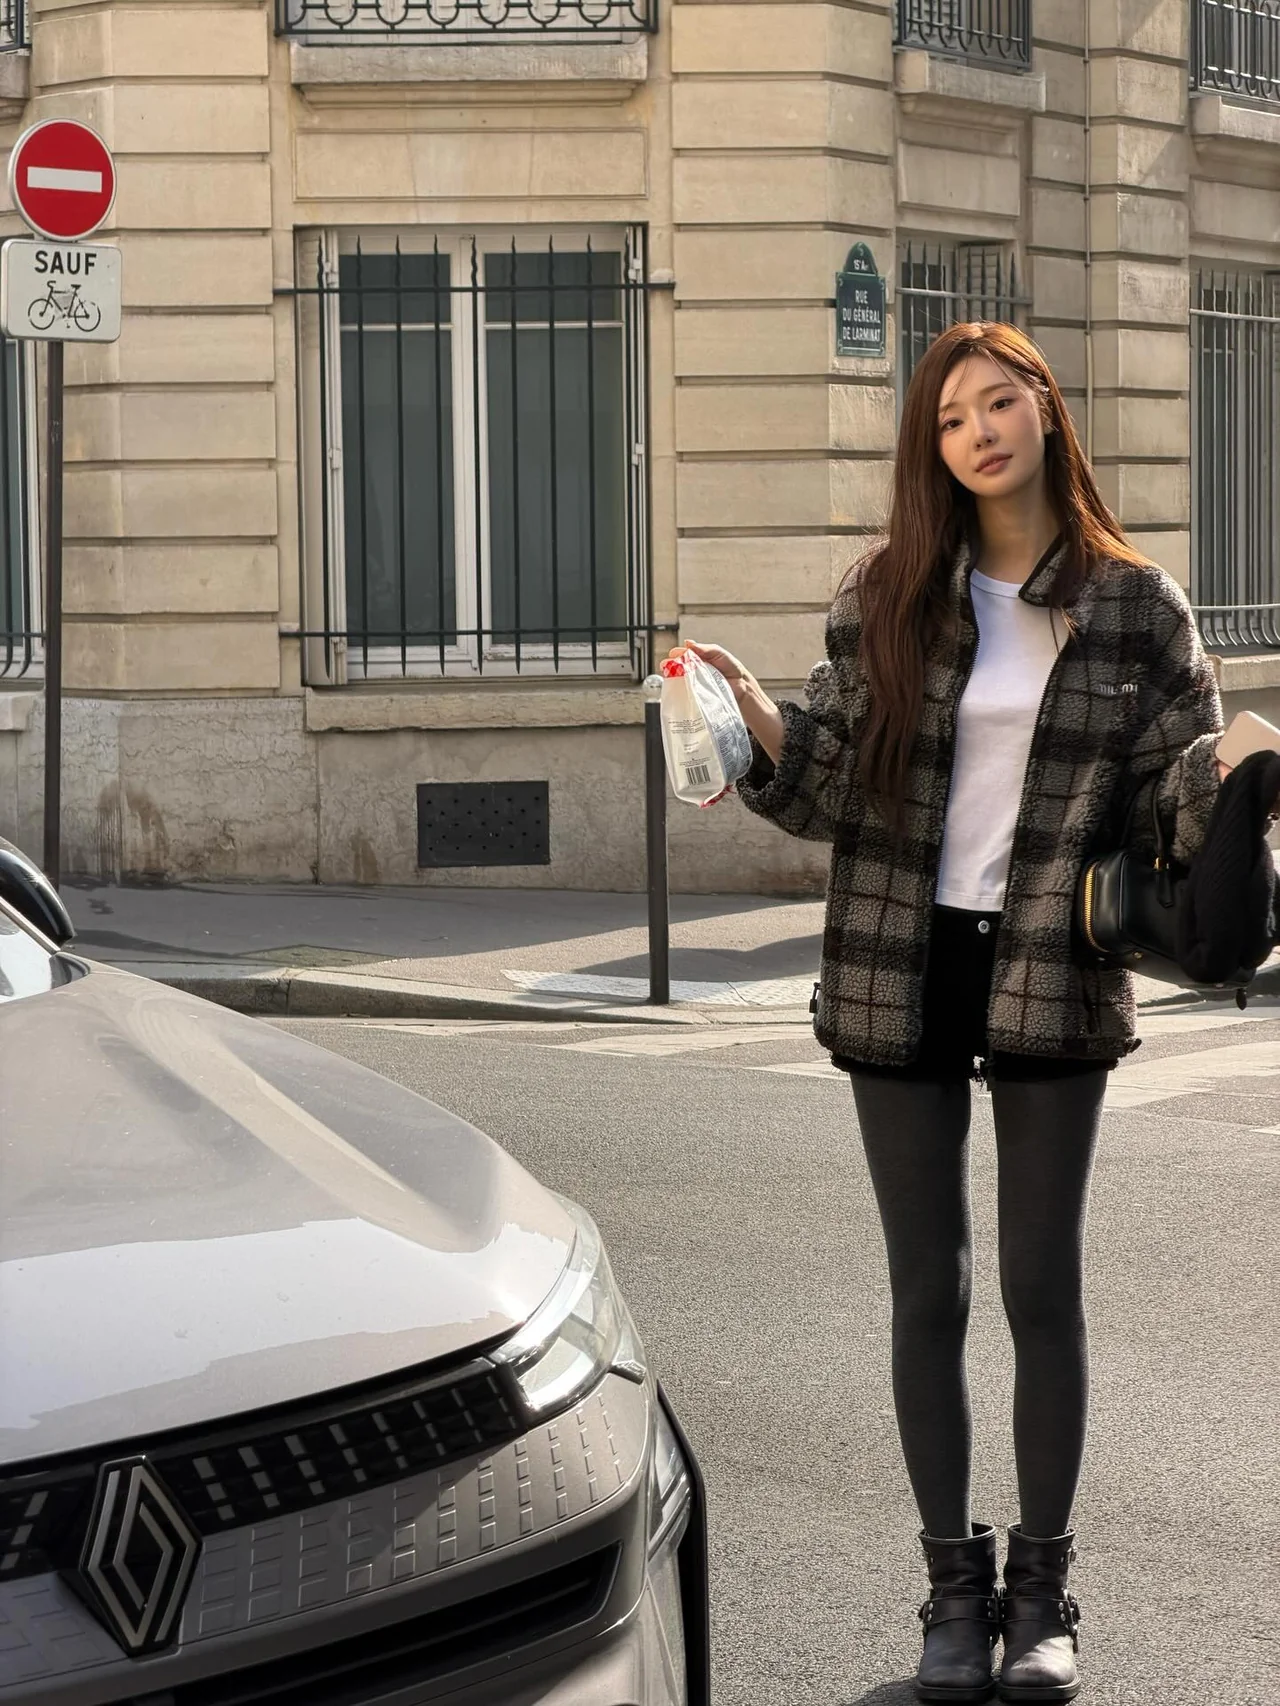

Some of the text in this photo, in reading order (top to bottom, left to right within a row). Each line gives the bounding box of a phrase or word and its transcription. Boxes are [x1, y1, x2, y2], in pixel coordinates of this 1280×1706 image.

[34, 250, 97, 275] SAUF
[855, 290, 868, 304] RUE
[842, 306, 881, 324] DU GÉNÉRAL
[842, 326, 881, 342] DE LARMINAT
